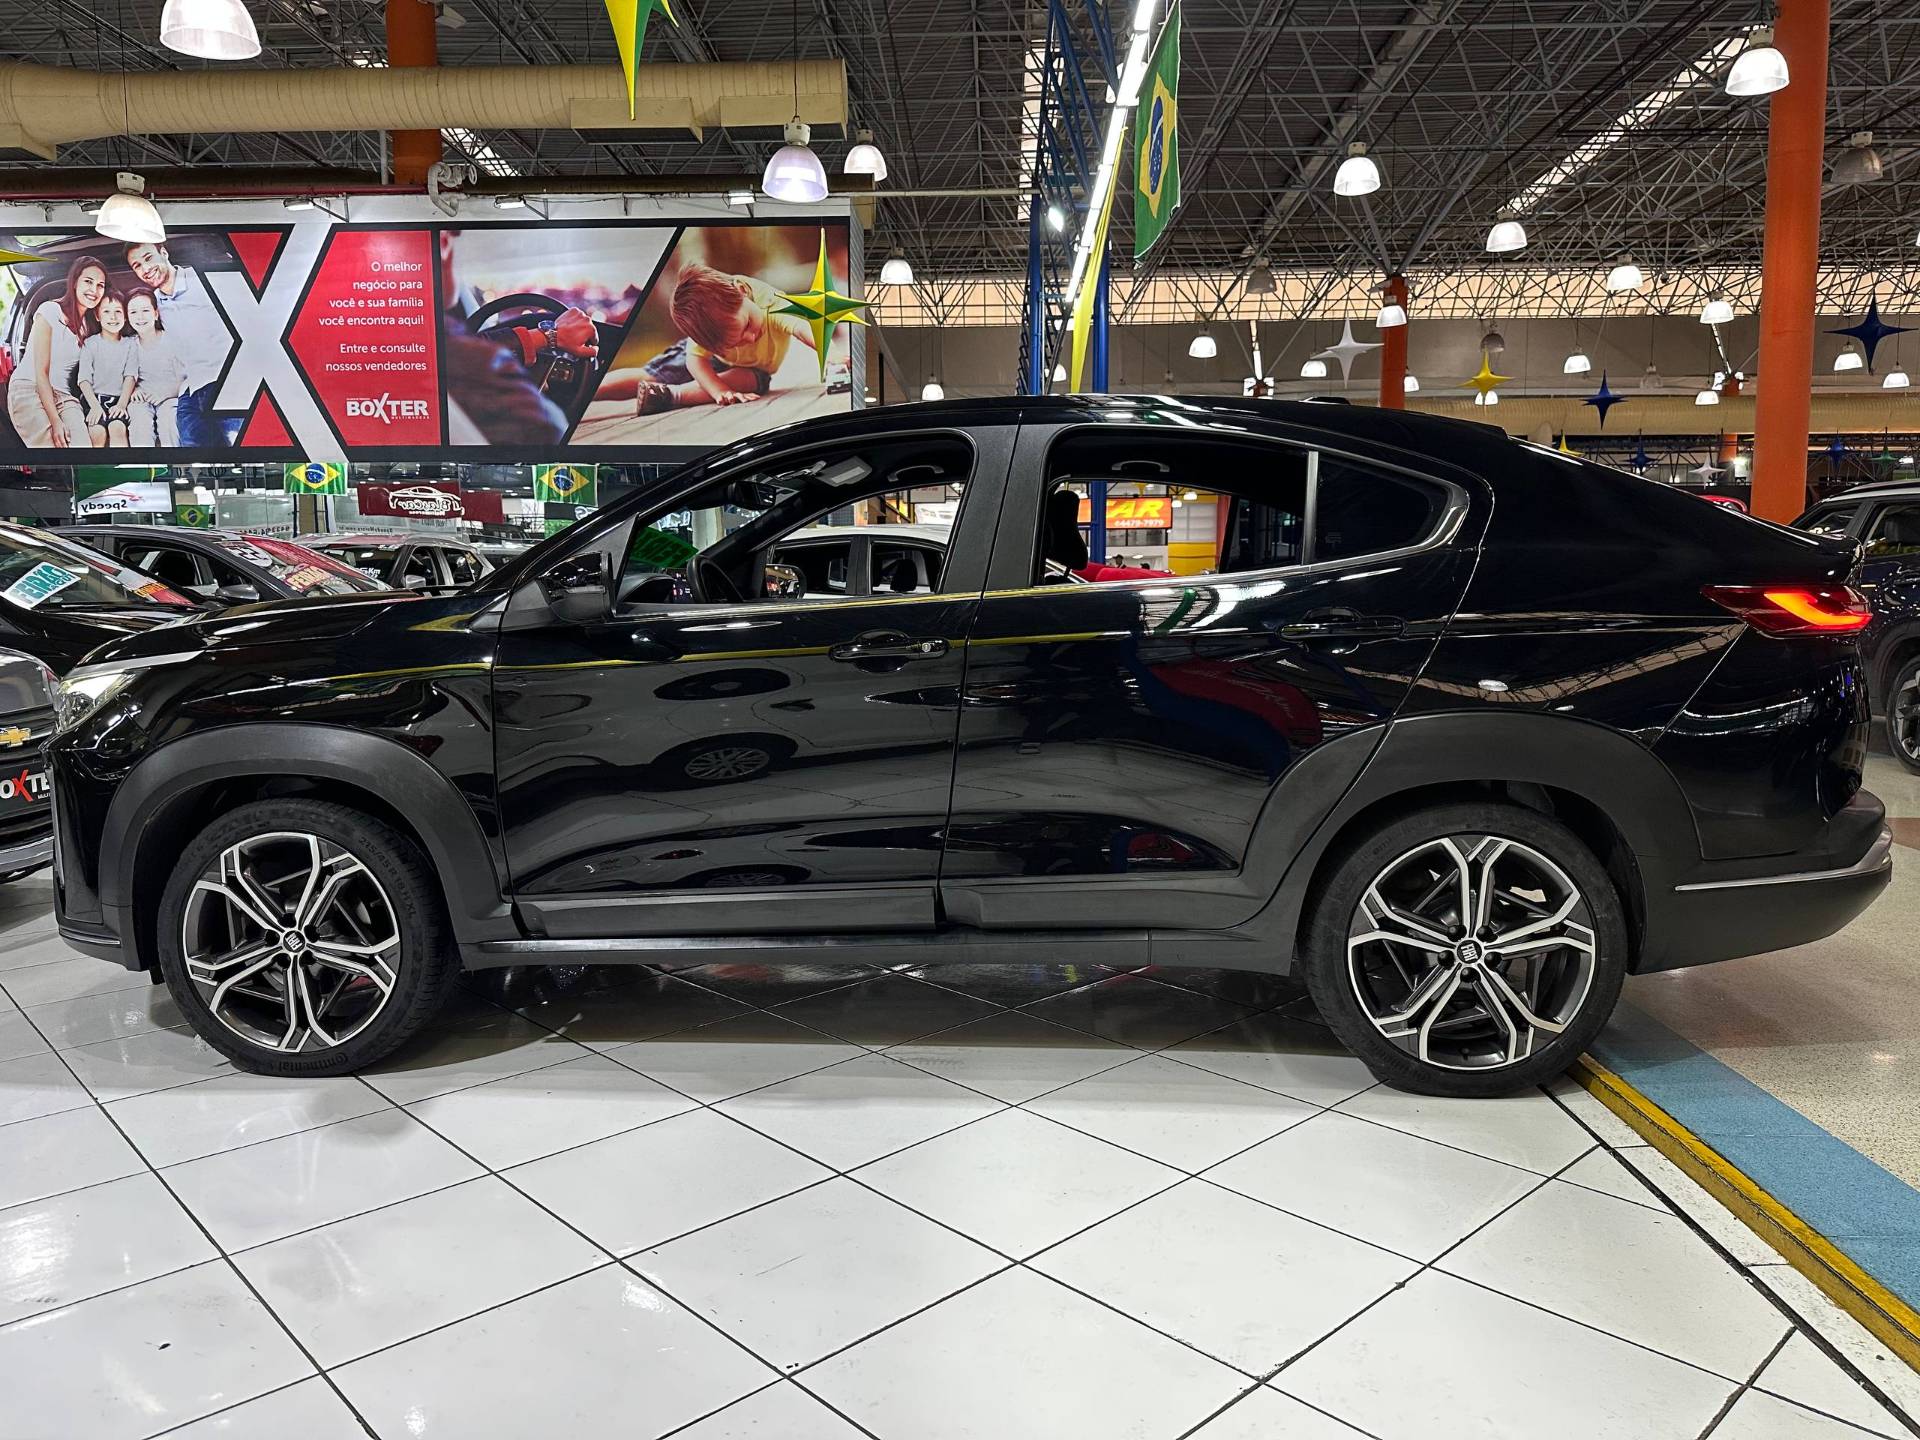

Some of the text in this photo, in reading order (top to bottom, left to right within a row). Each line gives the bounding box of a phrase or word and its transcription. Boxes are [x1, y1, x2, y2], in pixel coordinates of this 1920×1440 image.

[371, 261, 422, 272] O melhor
[353, 280, 423, 292] negócio para
[329, 297, 424, 308] você e sua família
[319, 315, 424, 327] você encontra aqui!
[340, 343, 426, 353] Entre e consulte
[326, 361, 427, 371] nossos vendedores
[346, 392, 429, 424] BOXTER
[0, 769, 50, 802] OXTE
[285, 932, 303, 951] FIAT
[1460, 943, 1479, 961] FIAT
[278, 1052, 349, 1072] Continental
